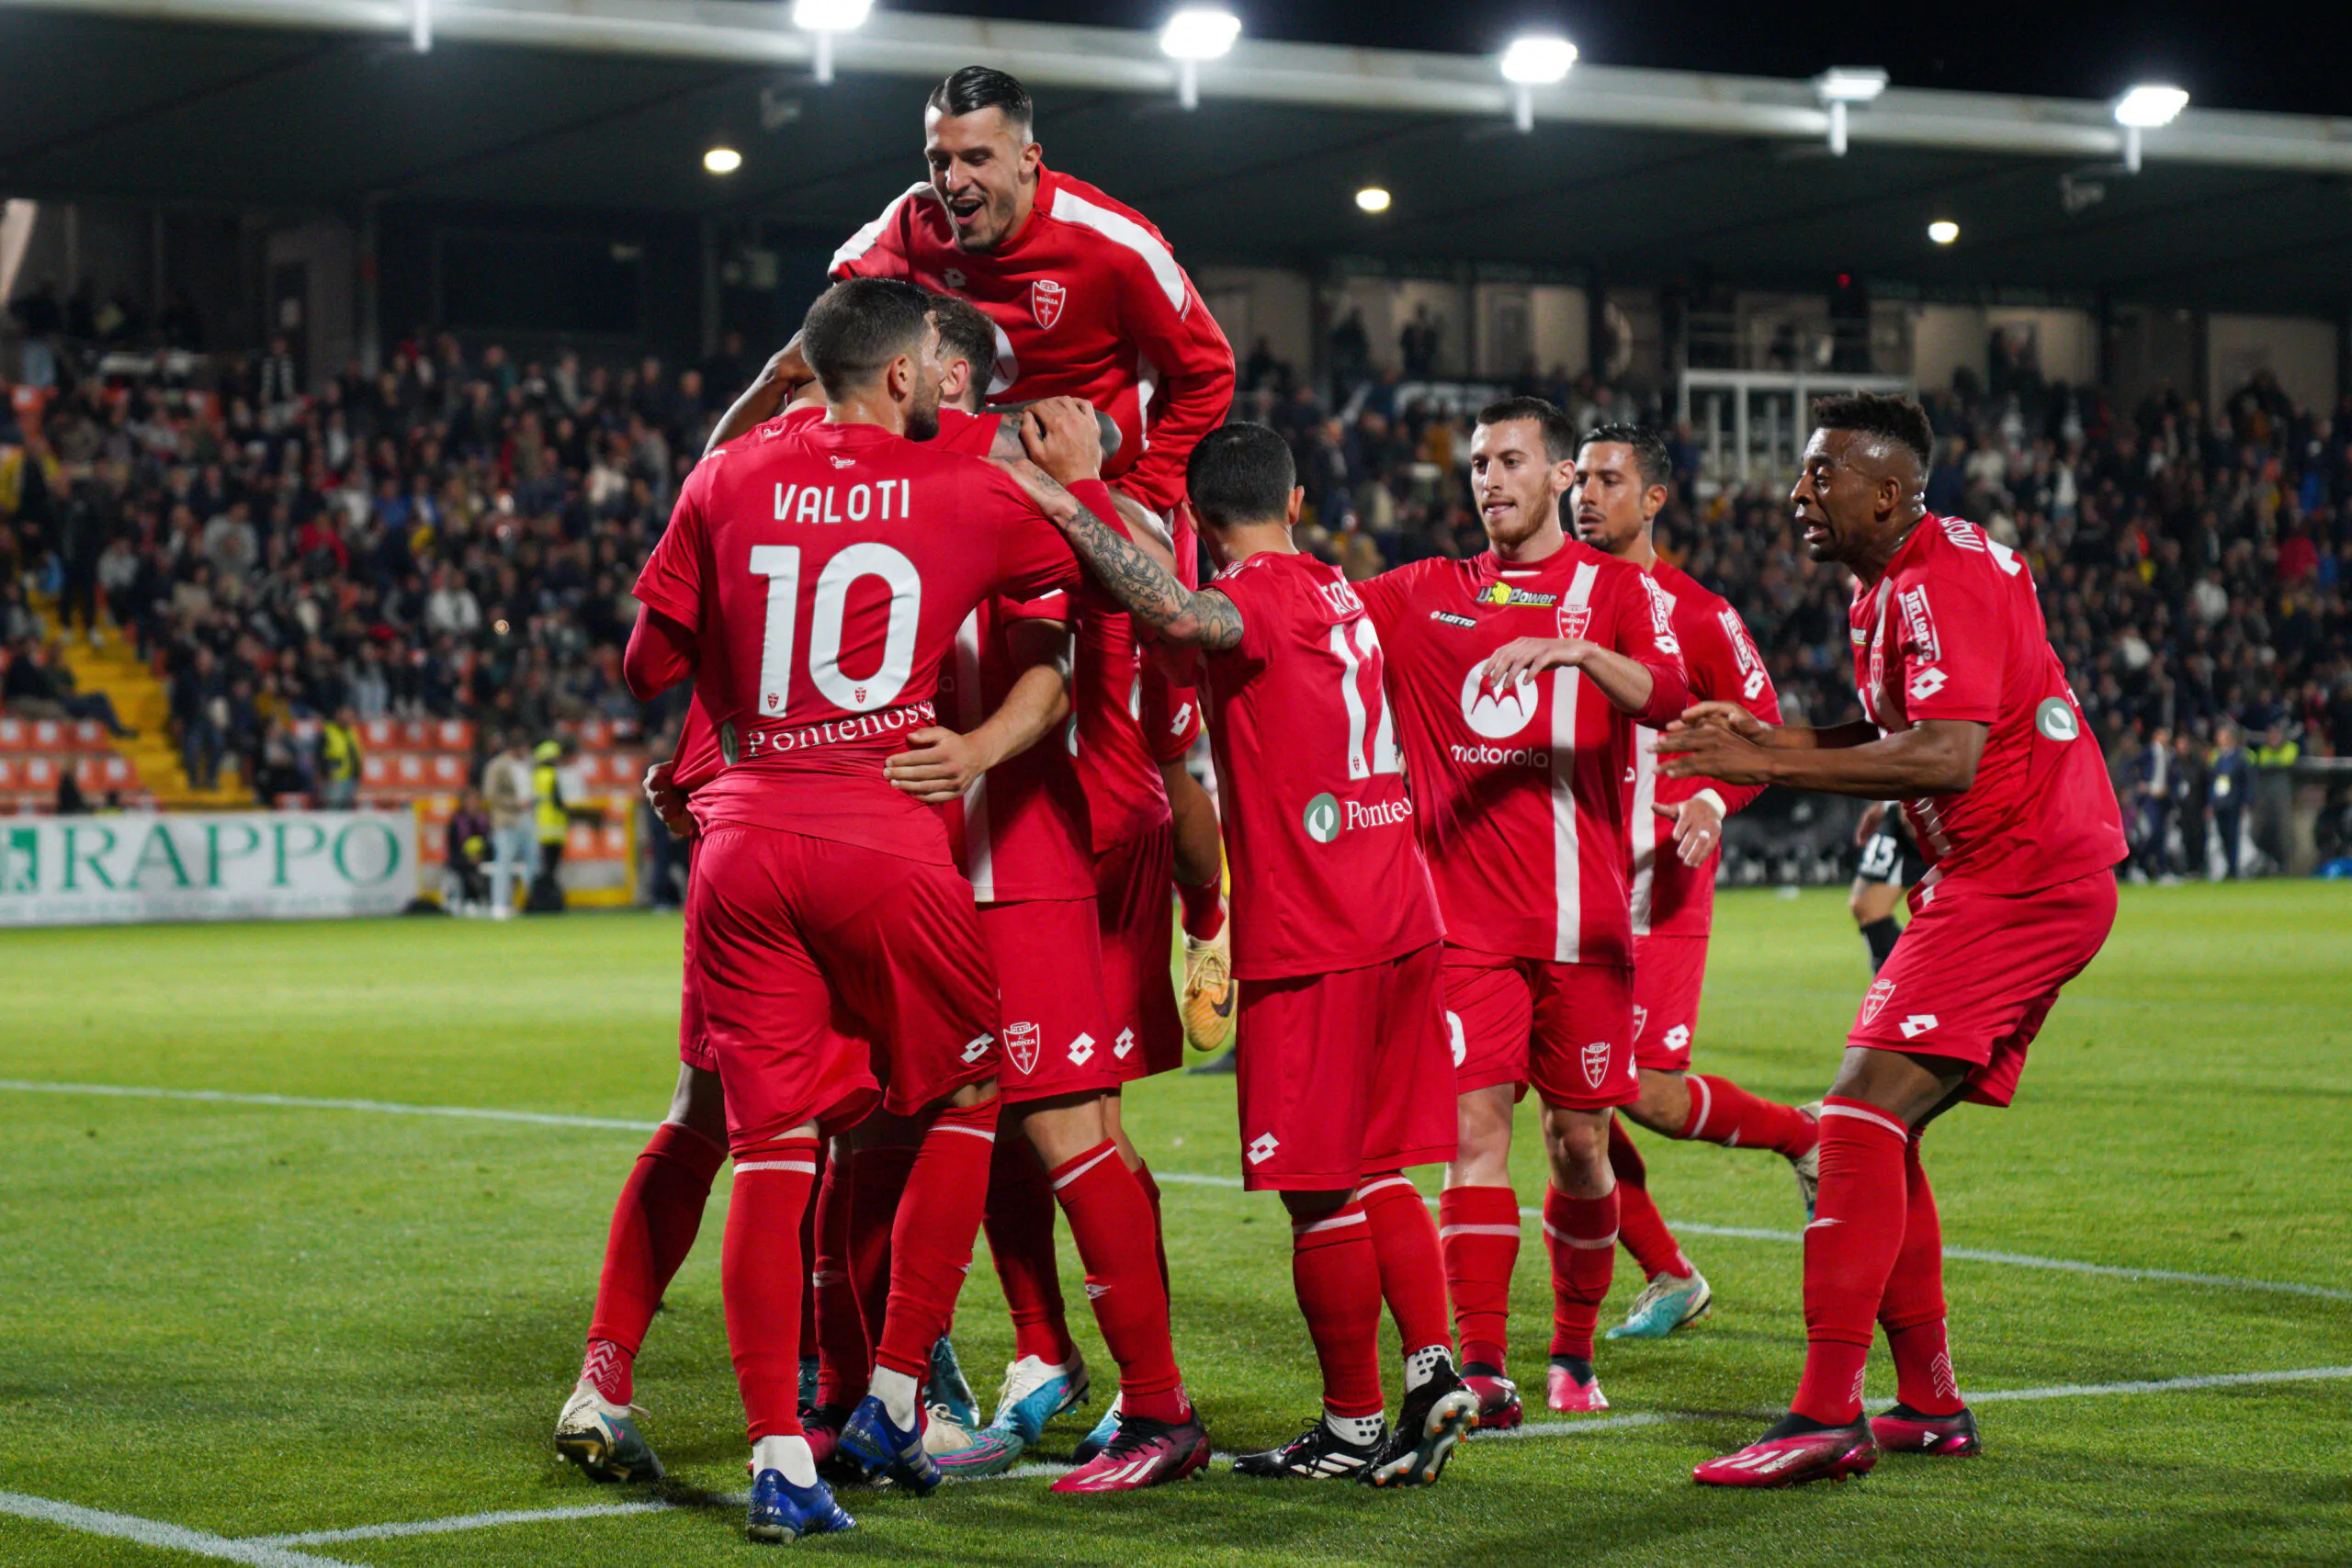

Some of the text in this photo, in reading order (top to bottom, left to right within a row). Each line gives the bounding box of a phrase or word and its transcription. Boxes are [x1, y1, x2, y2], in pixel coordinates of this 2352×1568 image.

[774, 479, 910, 524] VALOTI
[749, 542, 922, 717] 10
[1439, 613, 1477, 627] LOTTO
[1451, 744, 1549, 768] motorola
[61, 817, 401, 890] RAPPO
[1010, 1038, 1036, 1048] MONZA
